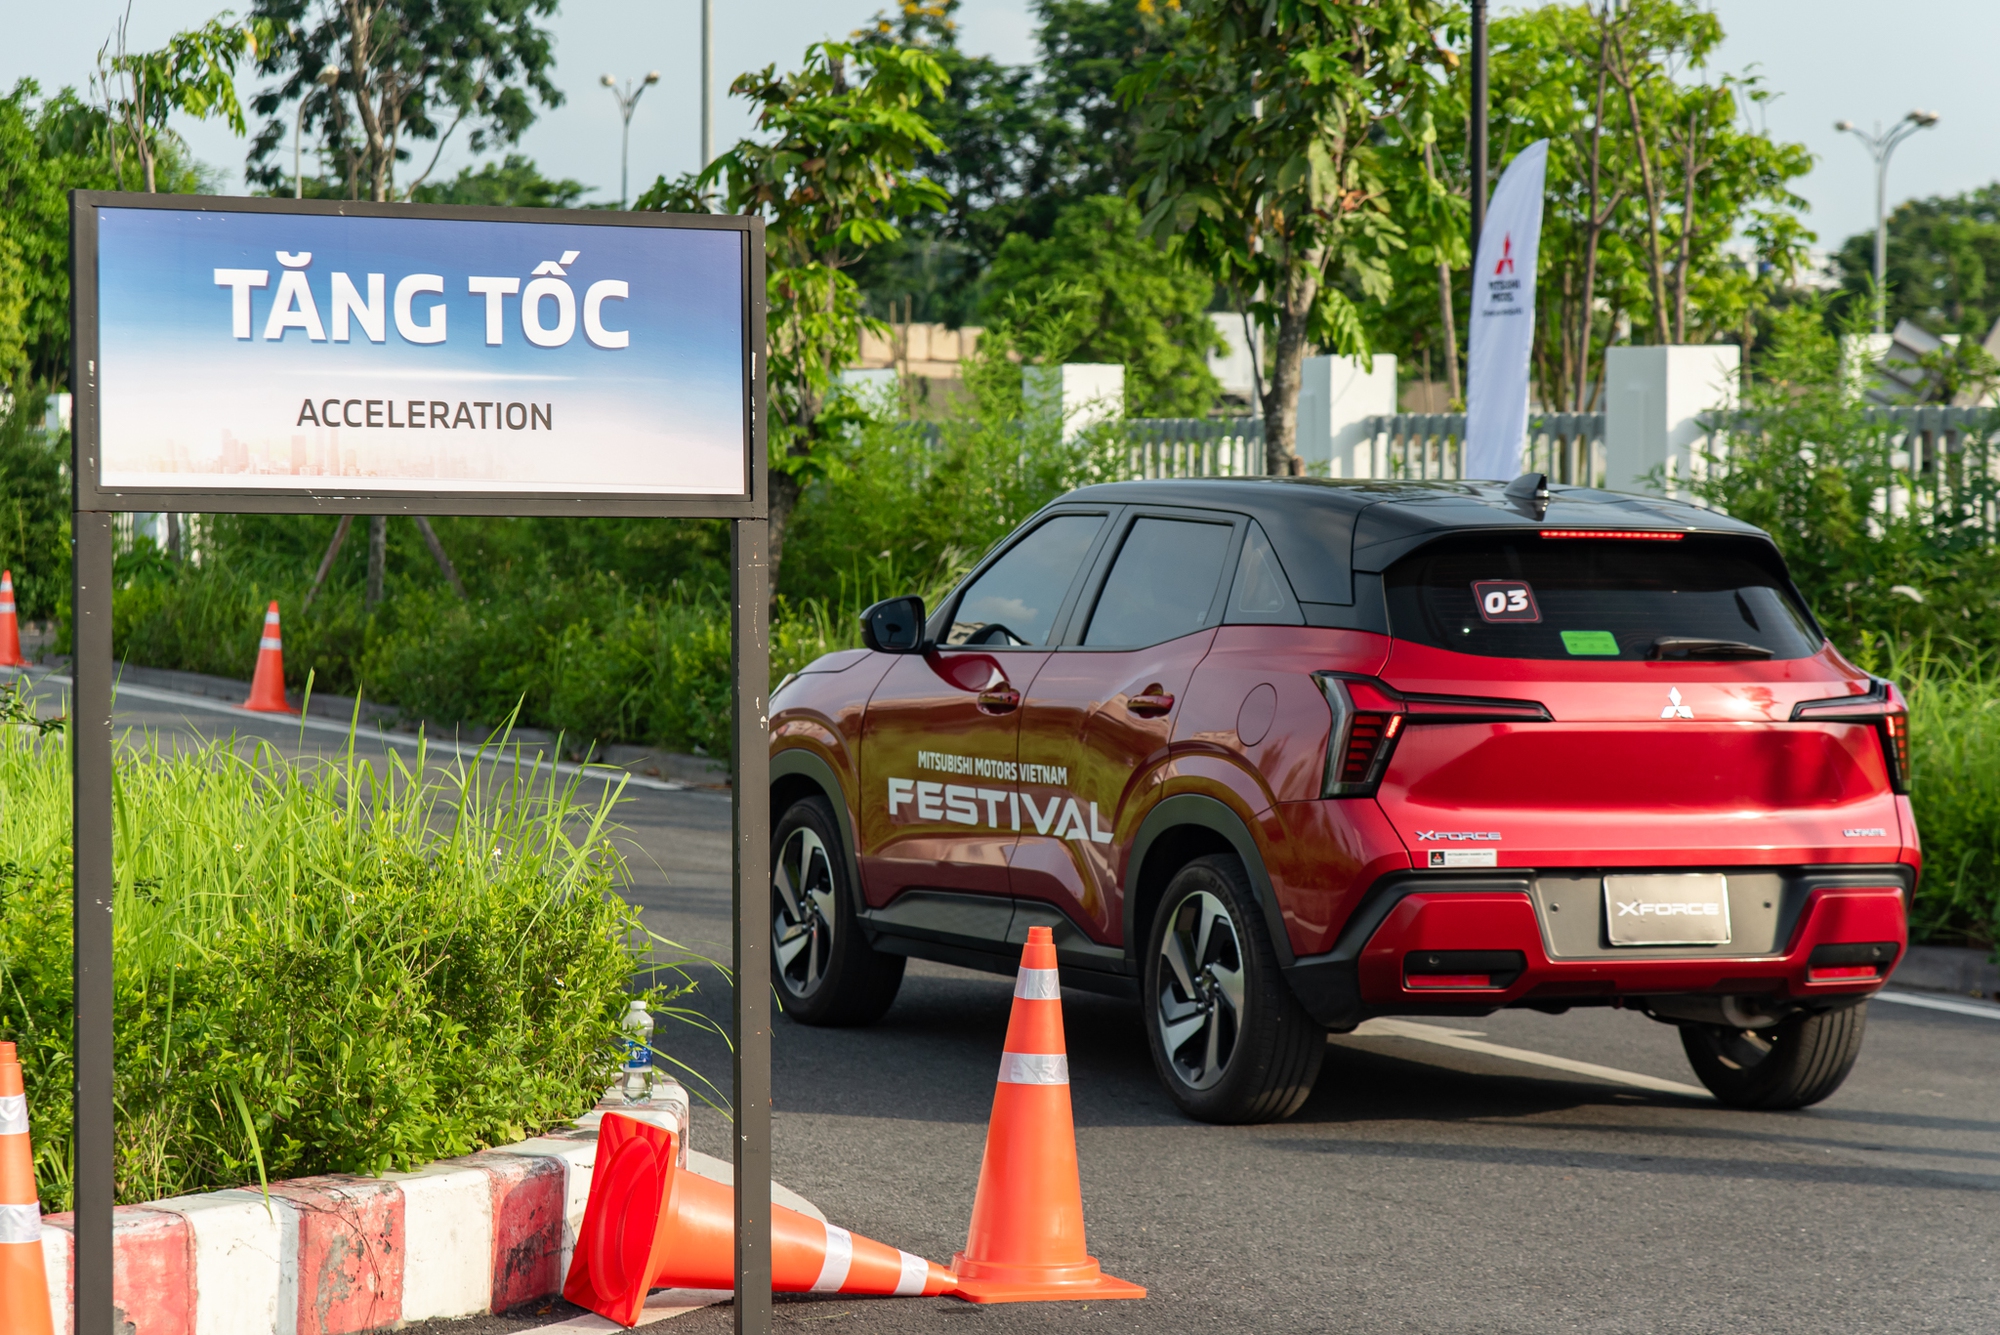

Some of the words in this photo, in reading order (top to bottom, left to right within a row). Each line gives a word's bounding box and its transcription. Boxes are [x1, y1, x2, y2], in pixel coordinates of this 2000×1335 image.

[213, 250, 448, 345] TĂNG
[468, 250, 630, 349] TỐC
[296, 398, 553, 431] ACCELERATION
[1484, 589, 1529, 614] 03
[917, 750, 973, 776] MITSUBISHI
[974, 757, 1018, 782] MOTORS
[1018, 763, 1068, 786] VIETNAM
[888, 777, 1115, 845] FESTIVAL
[1414, 829, 1503, 842] XFORCE
[1616, 901, 1720, 917] XFORCE
